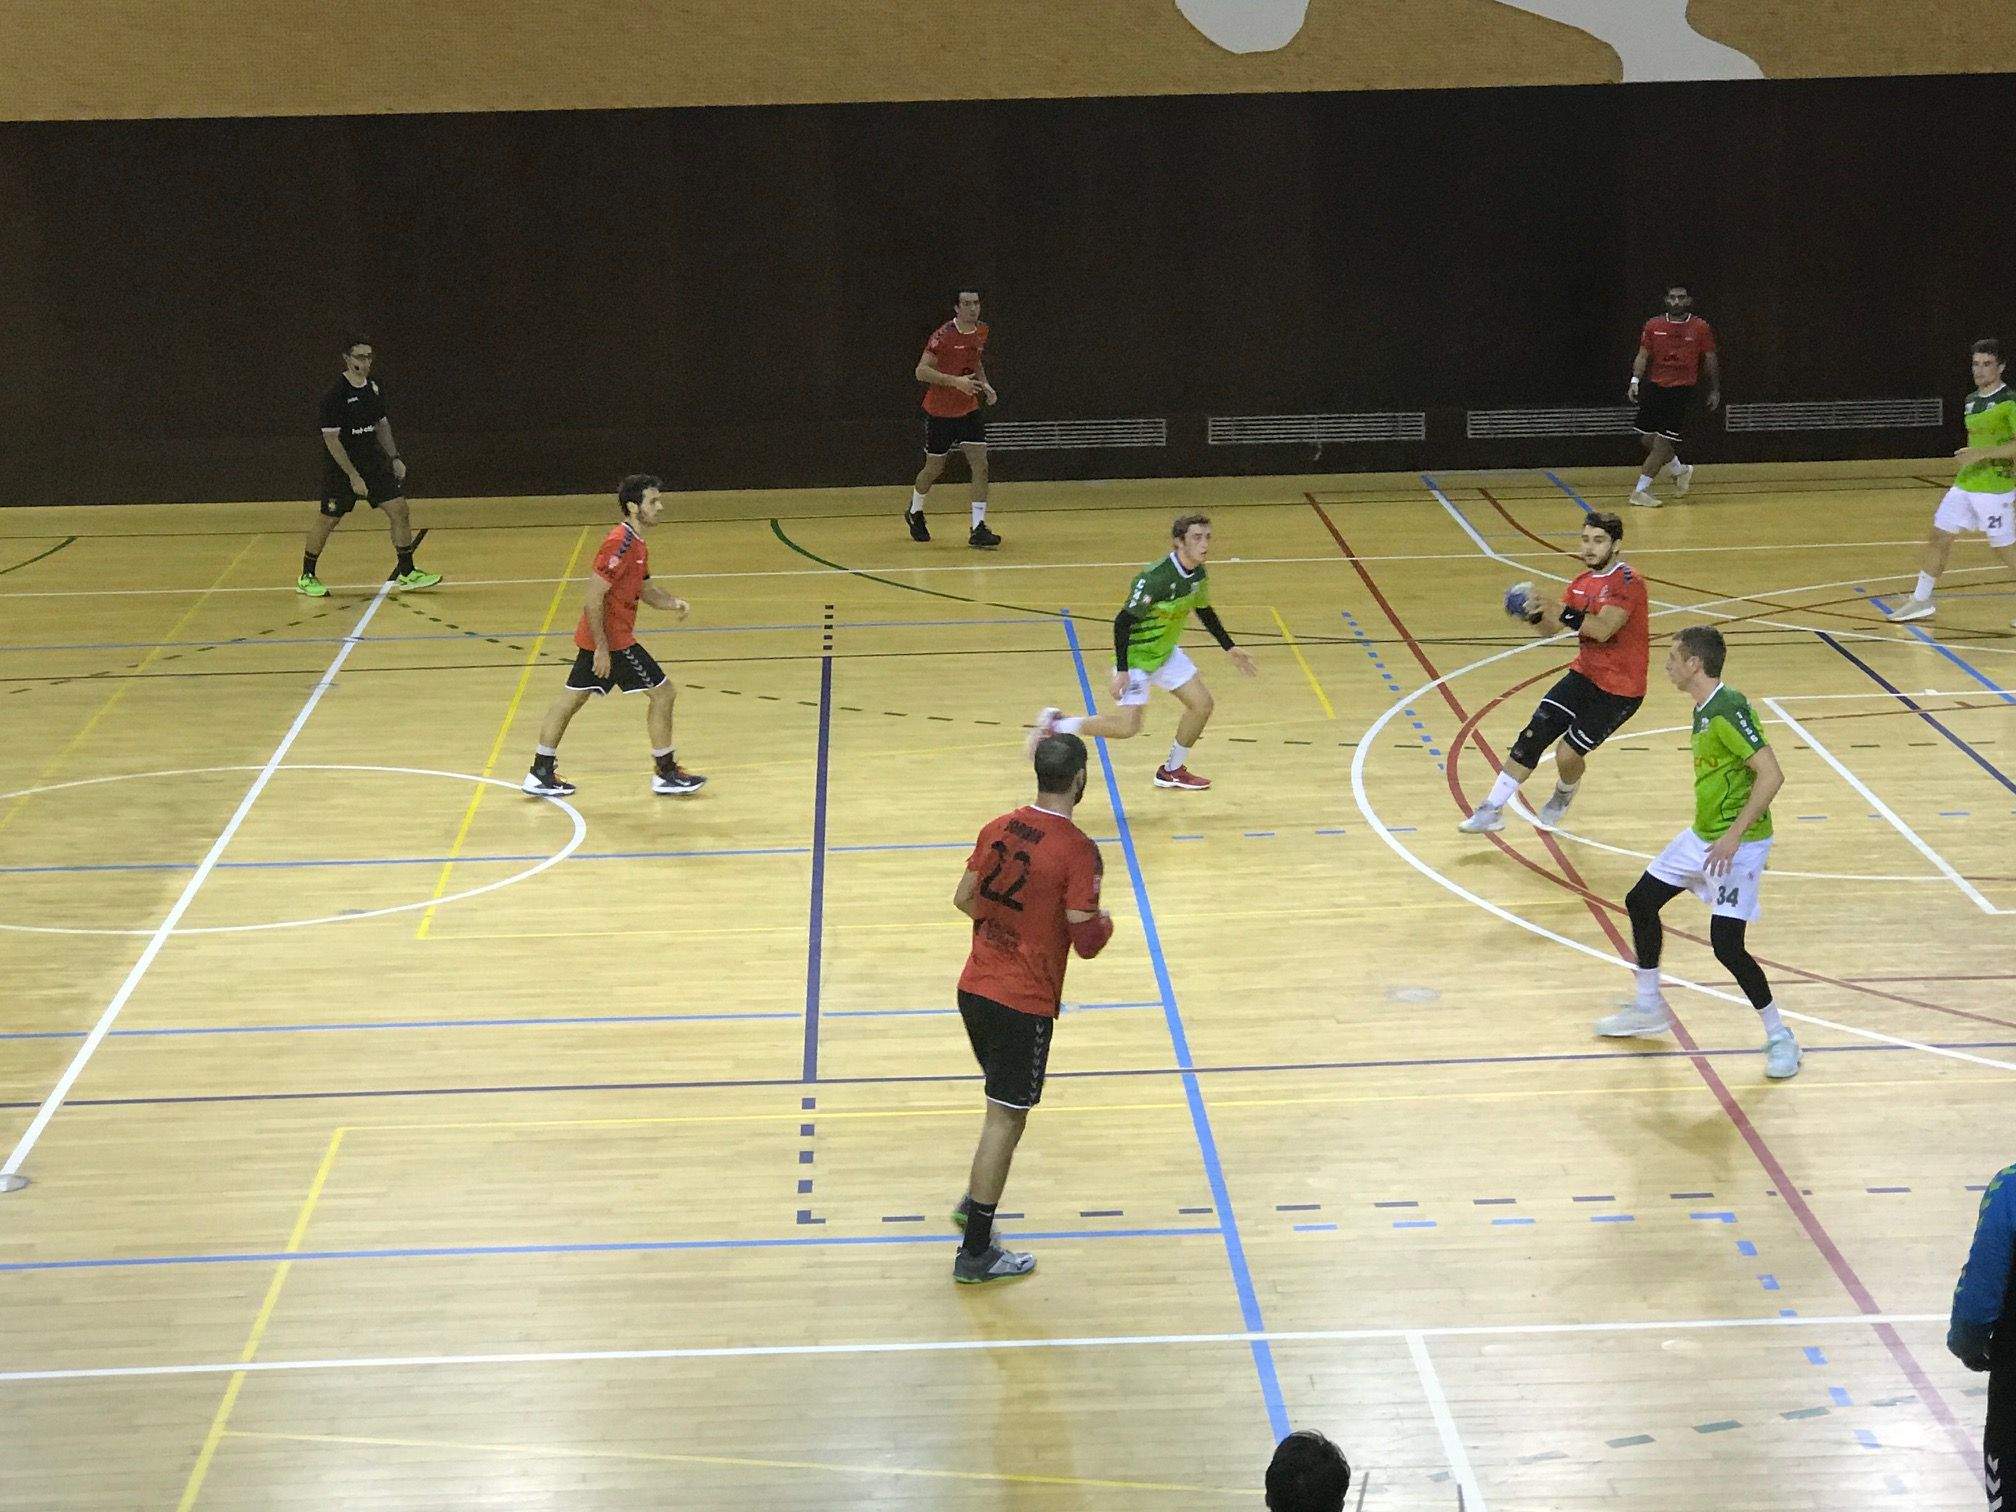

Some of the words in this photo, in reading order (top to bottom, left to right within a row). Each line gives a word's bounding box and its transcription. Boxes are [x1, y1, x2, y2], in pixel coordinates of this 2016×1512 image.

[1987, 515, 2002, 529] 21
[980, 840, 1031, 912] 22
[1716, 885, 1740, 908] 34
